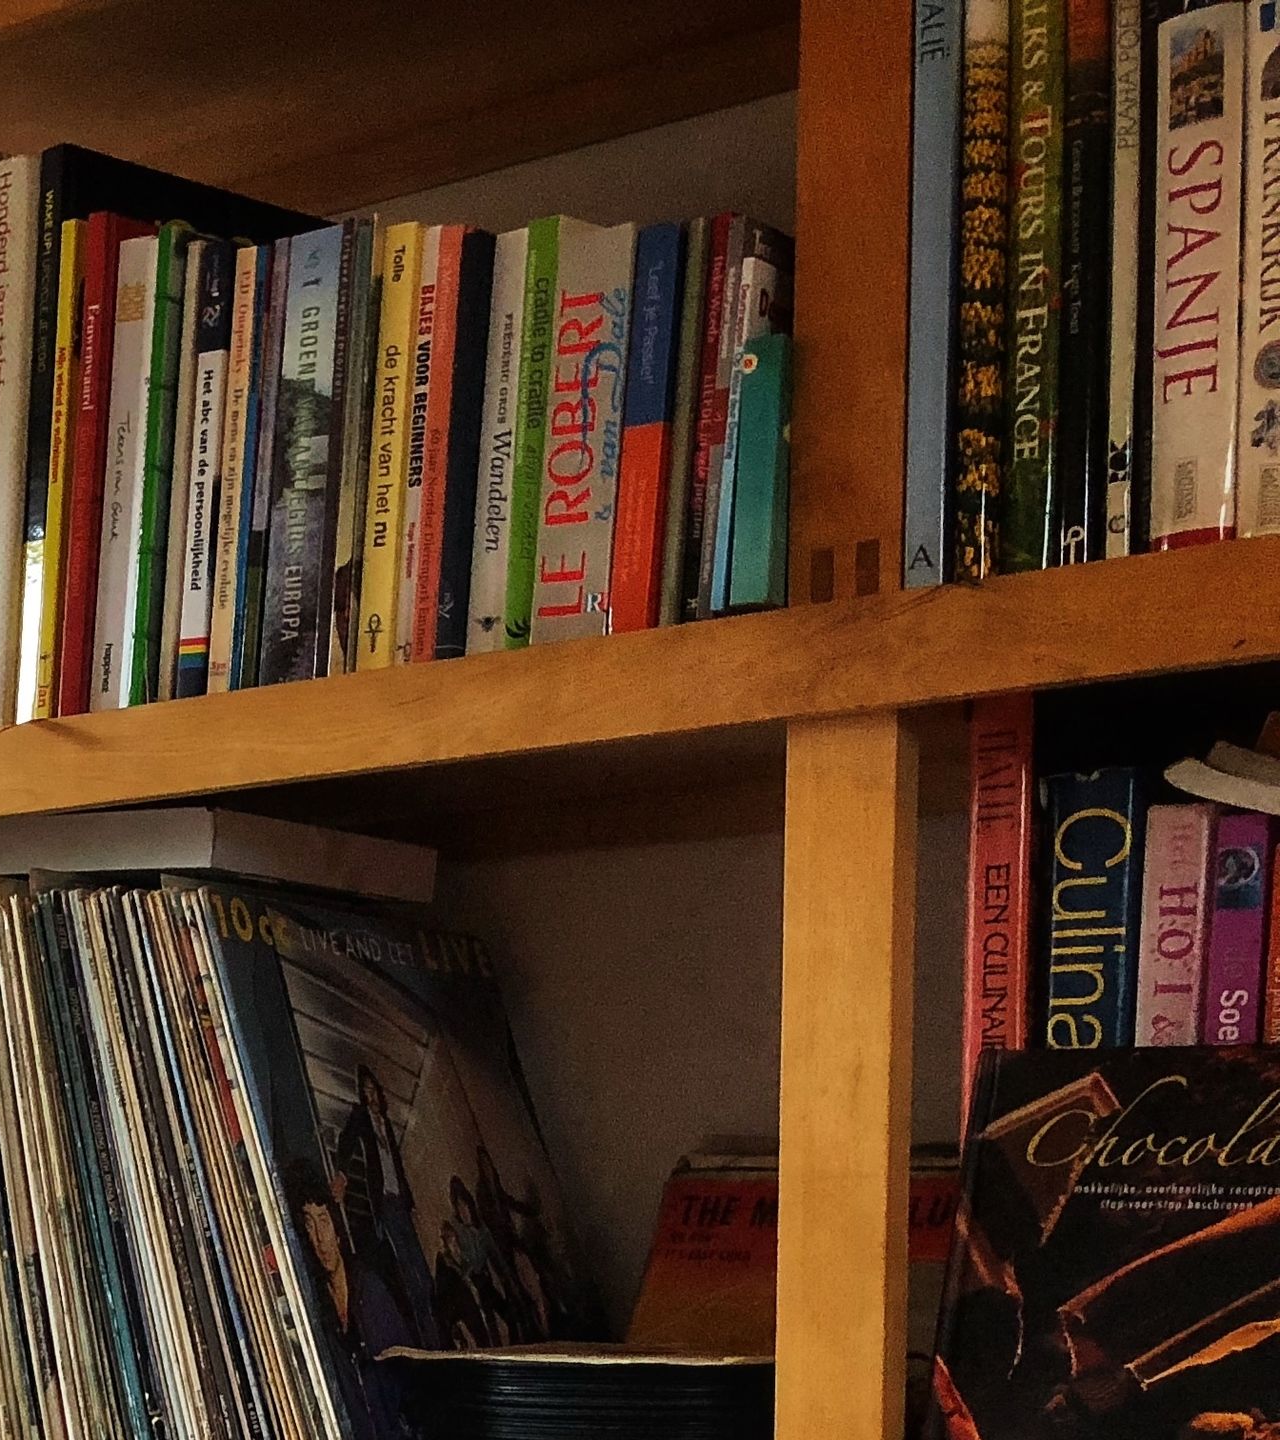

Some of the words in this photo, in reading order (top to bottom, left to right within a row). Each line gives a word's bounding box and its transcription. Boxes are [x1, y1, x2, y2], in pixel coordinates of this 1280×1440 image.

[1020, 80, 1044, 102] &
[1018, 104, 1053, 240] TOURS
[392, 246, 406, 283] Tolle
[1017, 250, 1046, 292] IN
[1157, 140, 1224, 405] SPANJE
[419, 283, 435, 335] BAJES
[533, 277, 550, 338] cradle
[386, 345, 400, 369] de
[415, 339, 432, 387] VOOR
[532, 344, 549, 362] to
[201, 369, 215, 396] Het
[380, 375, 400, 436] kracht
[527, 368, 546, 429] cradle
[545, 290, 606, 527] ROBERT
[1013, 305, 1049, 461] FRANCE
[200, 400, 214, 425] abc
[199, 430, 210, 454] van
[379, 442, 391, 477] van
[408, 391, 428, 488] BEGINNERS
[197, 459, 210, 476] de
[485, 429, 513, 554] Wandelen
[378, 484, 394, 514] het
[190, 481, 209, 591] persoonlijkheid
[374, 521, 387, 548] nu
[908, 543, 934, 570] A
[280, 564, 304, 643] EUROPA
[539, 551, 588, 620] LE
[985, 862, 1011, 925] EEN
[1046, 807, 1132, 1050] Culina
